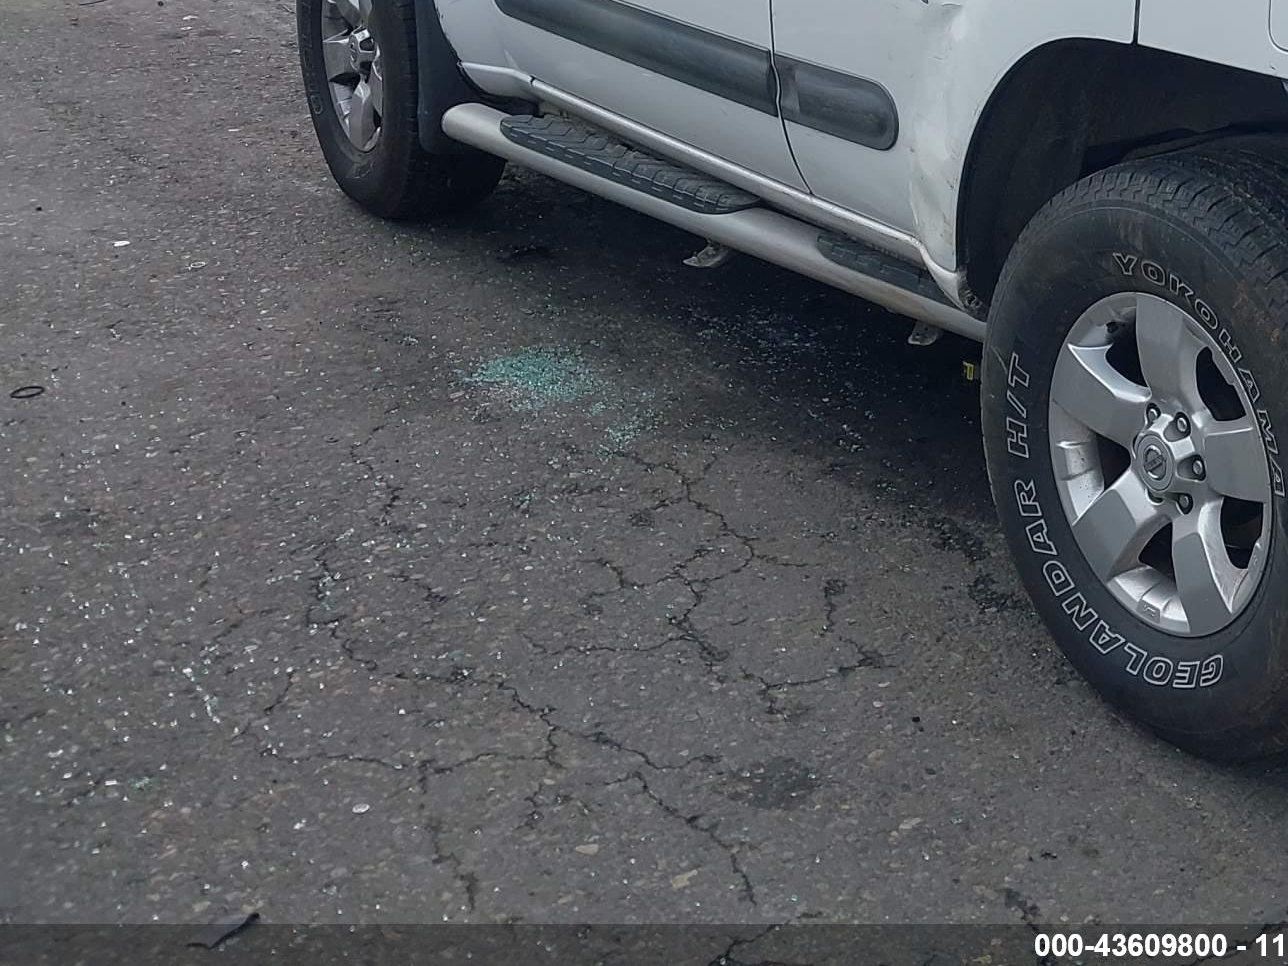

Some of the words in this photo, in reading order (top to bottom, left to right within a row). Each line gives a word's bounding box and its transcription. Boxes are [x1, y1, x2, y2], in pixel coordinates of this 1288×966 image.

[1006, 352, 1031, 458] H/T
[1112, 252, 1287, 498] YOKOHAMA
[1013, 479, 1224, 689] GEOLANDAR
